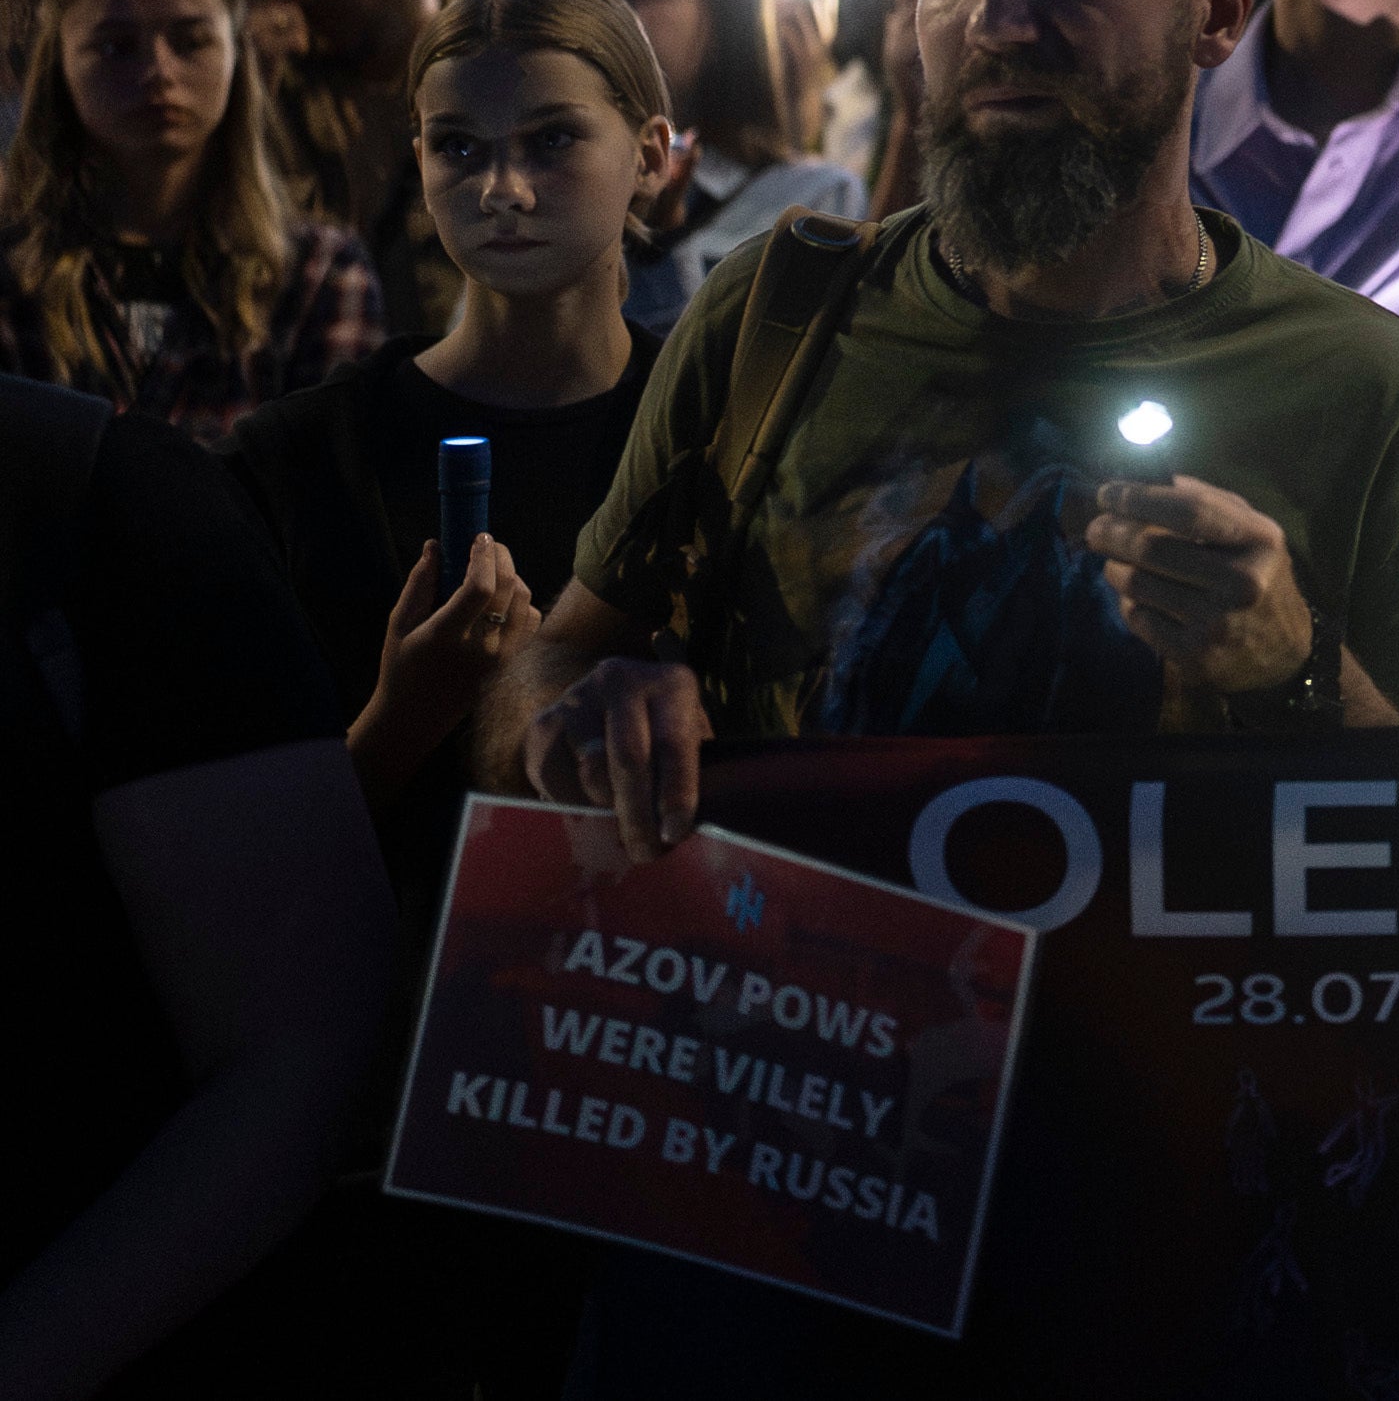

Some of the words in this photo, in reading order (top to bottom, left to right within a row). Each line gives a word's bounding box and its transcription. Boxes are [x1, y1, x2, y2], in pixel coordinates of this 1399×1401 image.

[564, 930, 727, 1003] AZOV
[737, 970, 898, 1057] POWS
[541, 1005, 700, 1085] WERE
[713, 1047, 896, 1139] VILELY
[446, 1071, 647, 1150] KILLED
[661, 1116, 736, 1174] BY
[747, 1141, 940, 1244] RUSSIA
